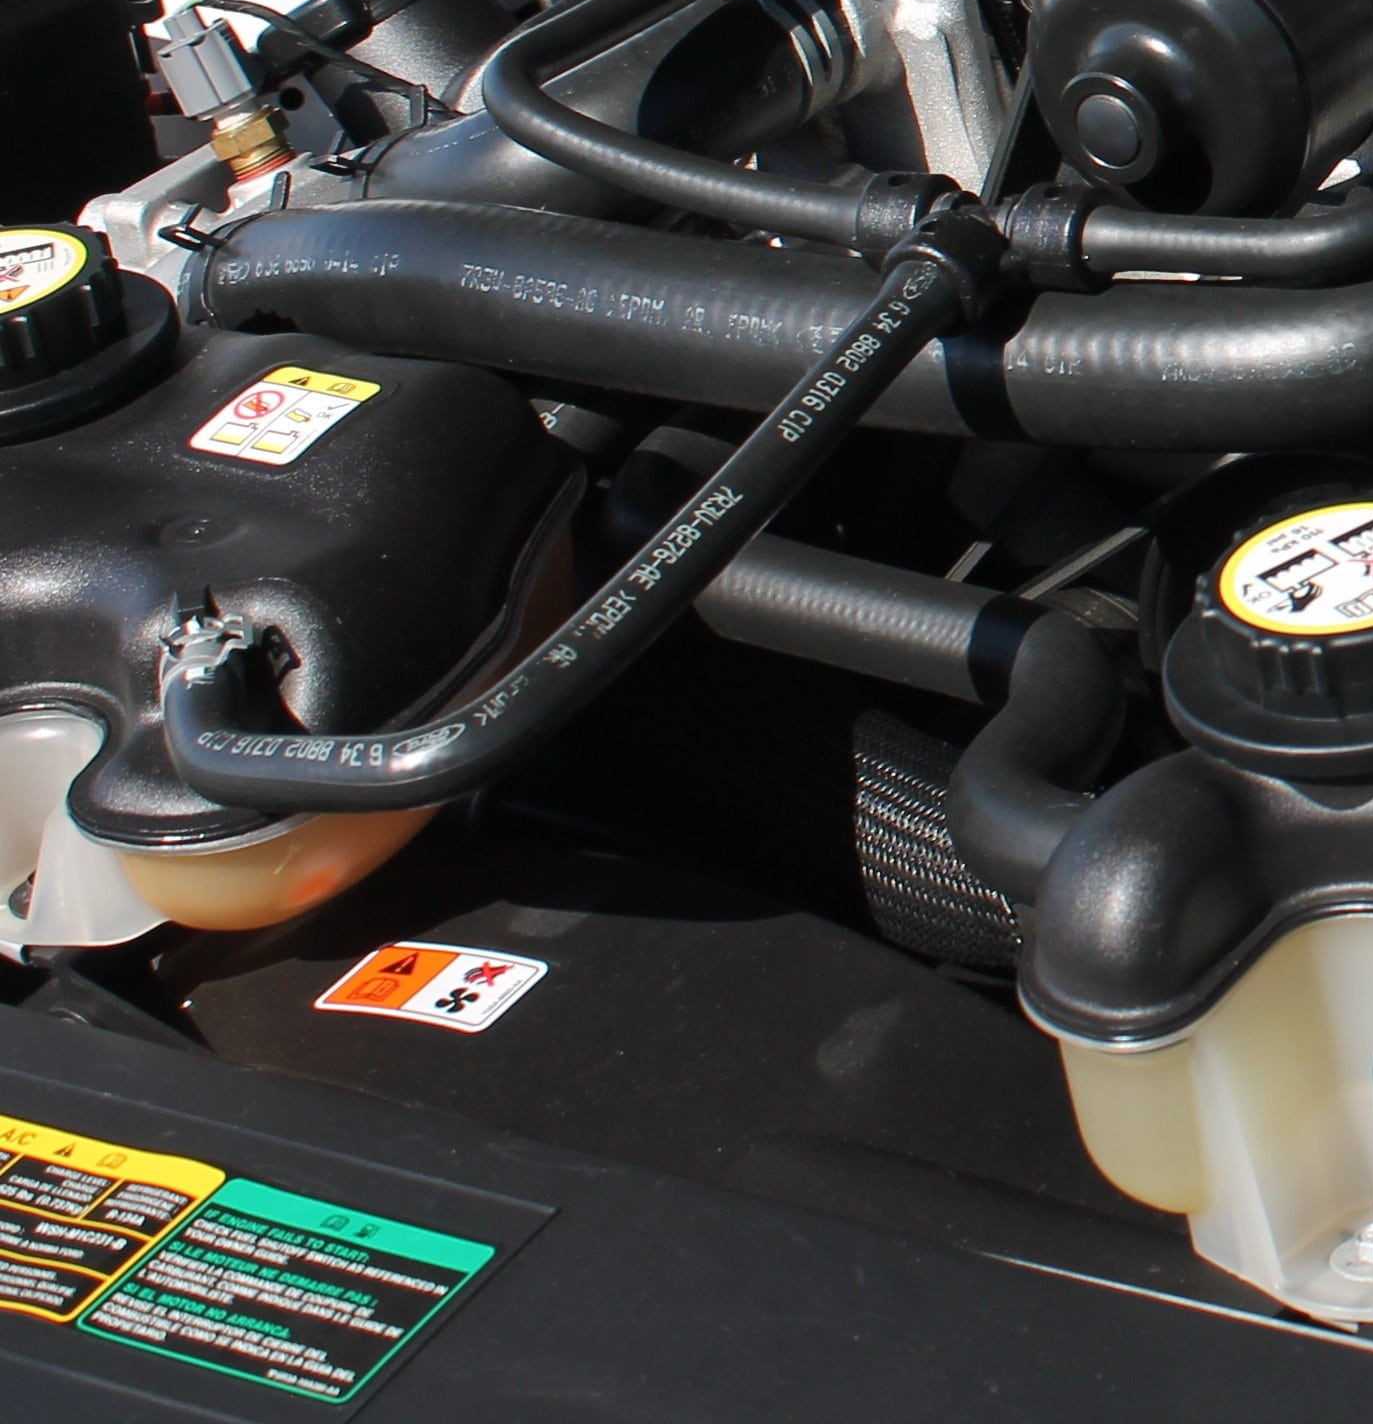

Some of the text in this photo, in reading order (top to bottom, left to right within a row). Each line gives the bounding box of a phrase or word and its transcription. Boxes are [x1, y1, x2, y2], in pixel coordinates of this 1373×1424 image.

[836, 333, 882, 372] 8802
[801, 371, 847, 412] 0316
[777, 409, 813, 443] CIP
[628, 485, 744, 591] 7R3V-8276-AE
[231, 736, 285, 758] 0316
[285, 738, 336, 762] 8802
[218, 1213, 269, 1234] ENGINE
[267, 1228, 304, 1244] FAILS
